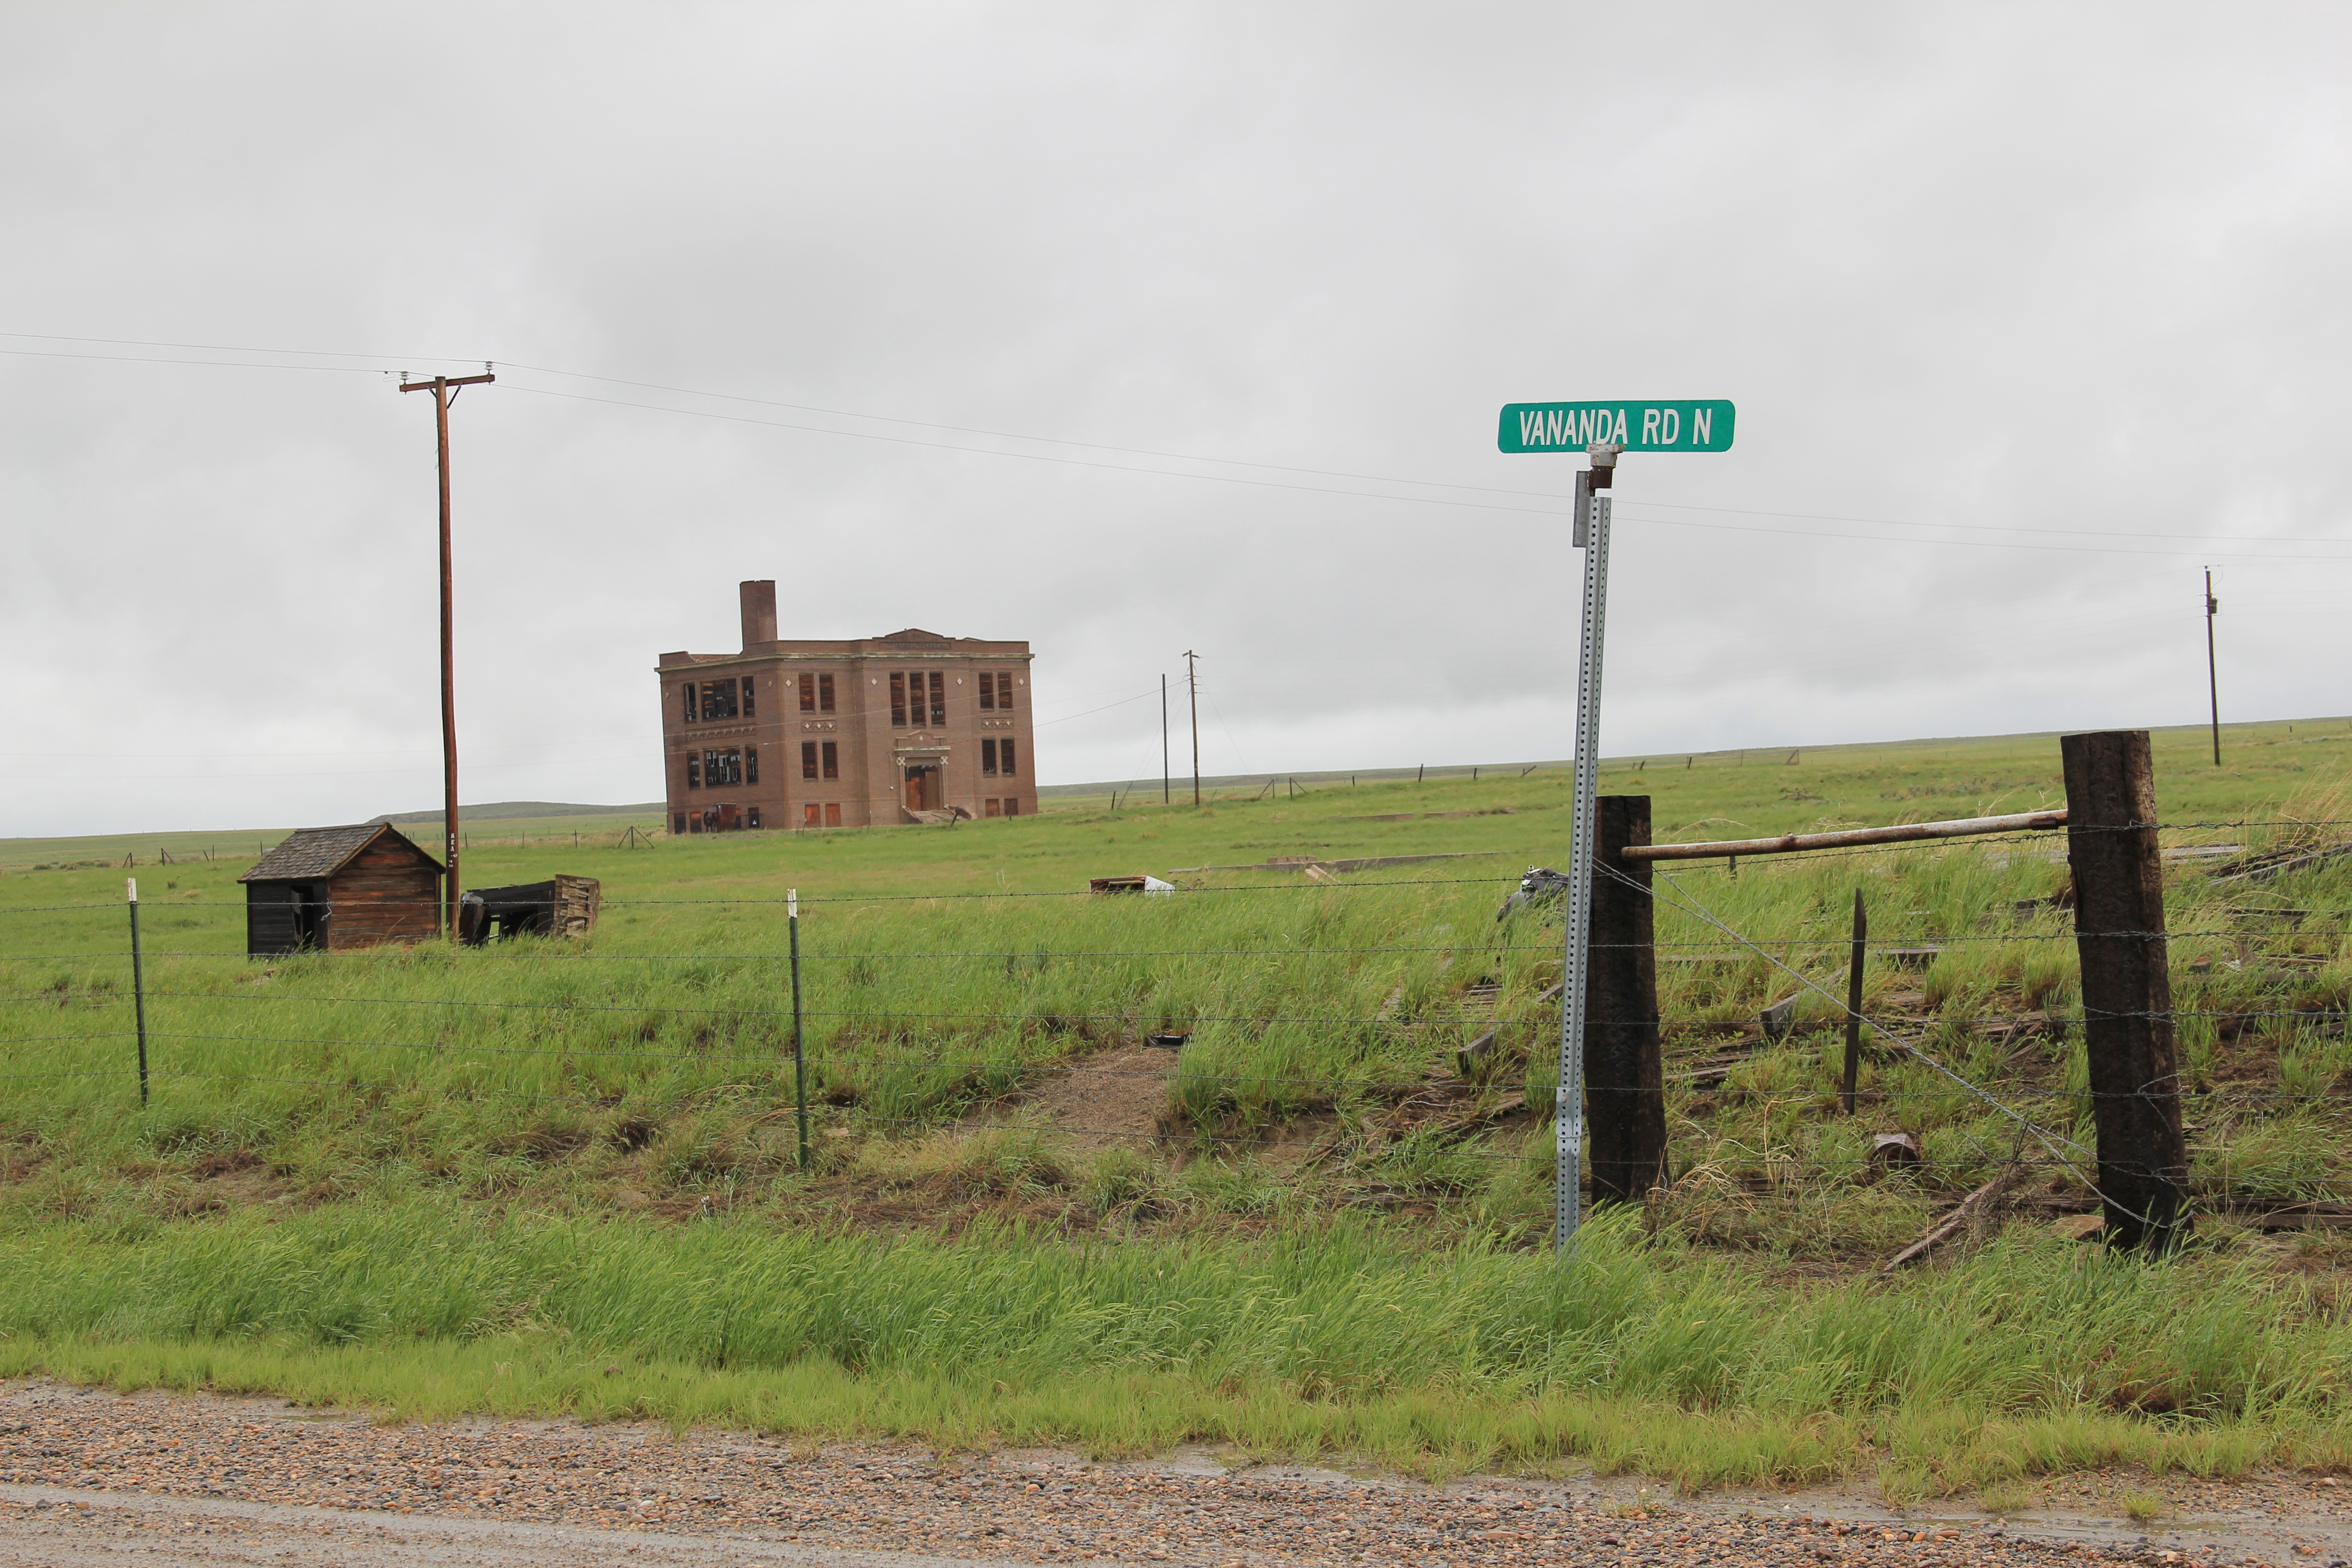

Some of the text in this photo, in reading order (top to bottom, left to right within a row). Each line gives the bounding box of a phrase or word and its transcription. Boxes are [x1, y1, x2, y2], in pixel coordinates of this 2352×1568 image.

[1520, 408, 1712, 446] VANANDA RD N
